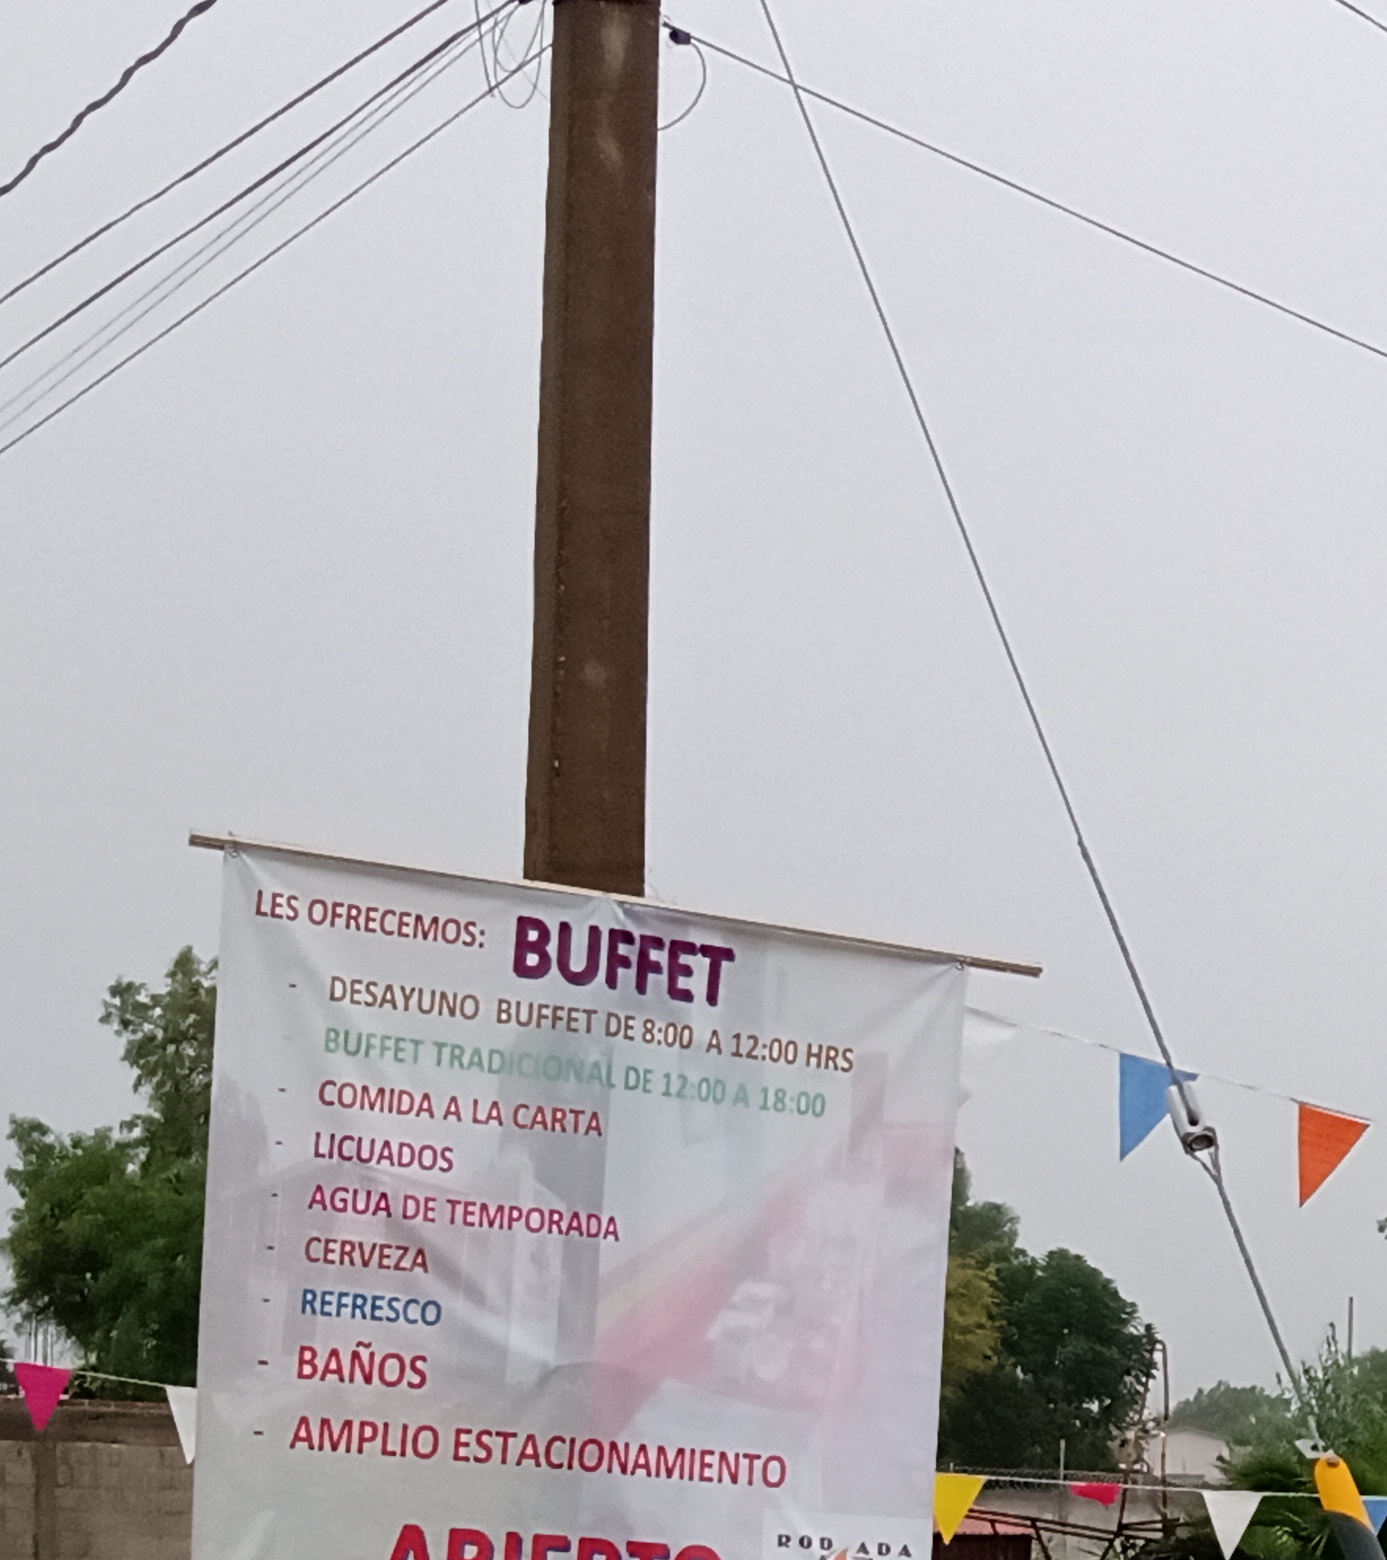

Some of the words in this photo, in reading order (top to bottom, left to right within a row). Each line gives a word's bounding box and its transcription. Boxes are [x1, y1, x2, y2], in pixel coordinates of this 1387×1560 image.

[255, 890, 299, 921] LES
[307, 899, 486, 948] OFRECEMOS:
[513, 915, 735, 1006] BUFFET
[329, 976, 480, 1020] DESAYUNO
[497, 999, 598, 1034] BUFFET
[605, 1011, 635, 1041] DE
[642, 1019, 693, 1049] 8:00
[706, 1030, 723, 1055] A
[731, 1033, 798, 1065] 12:00
[805, 1043, 854, 1072] HRS
[324, 1027, 426, 1065] BUFFET
[432, 1041, 616, 1088] TRADICIONAL
[624, 1066, 653, 1094] DE
[662, 1073, 725, 1105] 12:00
[732, 1083, 750, 1109] A
[759, 1086, 826, 1118] 18:00
[318, 1079, 435, 1119] COMIDA
[443, 1095, 462, 1122] A
[472, 1099, 504, 1127] LA
[512, 1103, 603, 1137] CARTA
[313, 1131, 454, 1173] LICUADOS
[307, 1184, 392, 1218] AGUA
[402, 1194, 437, 1223] DE
[446, 1198, 620, 1242] TEMPORADA
[304, 1236, 429, 1274] CERVEZA
[301, 1288, 442, 1327] REFRESCO
[296, 1340, 428, 1390] BAÑOS
[289, 1416, 440, 1460] AMPLIO
[453, 1427, 788, 1489] ESTACIONAMIENTO
[777, 1534, 833, 1551] ROD
[856, 1541, 912, 1558] ADA
